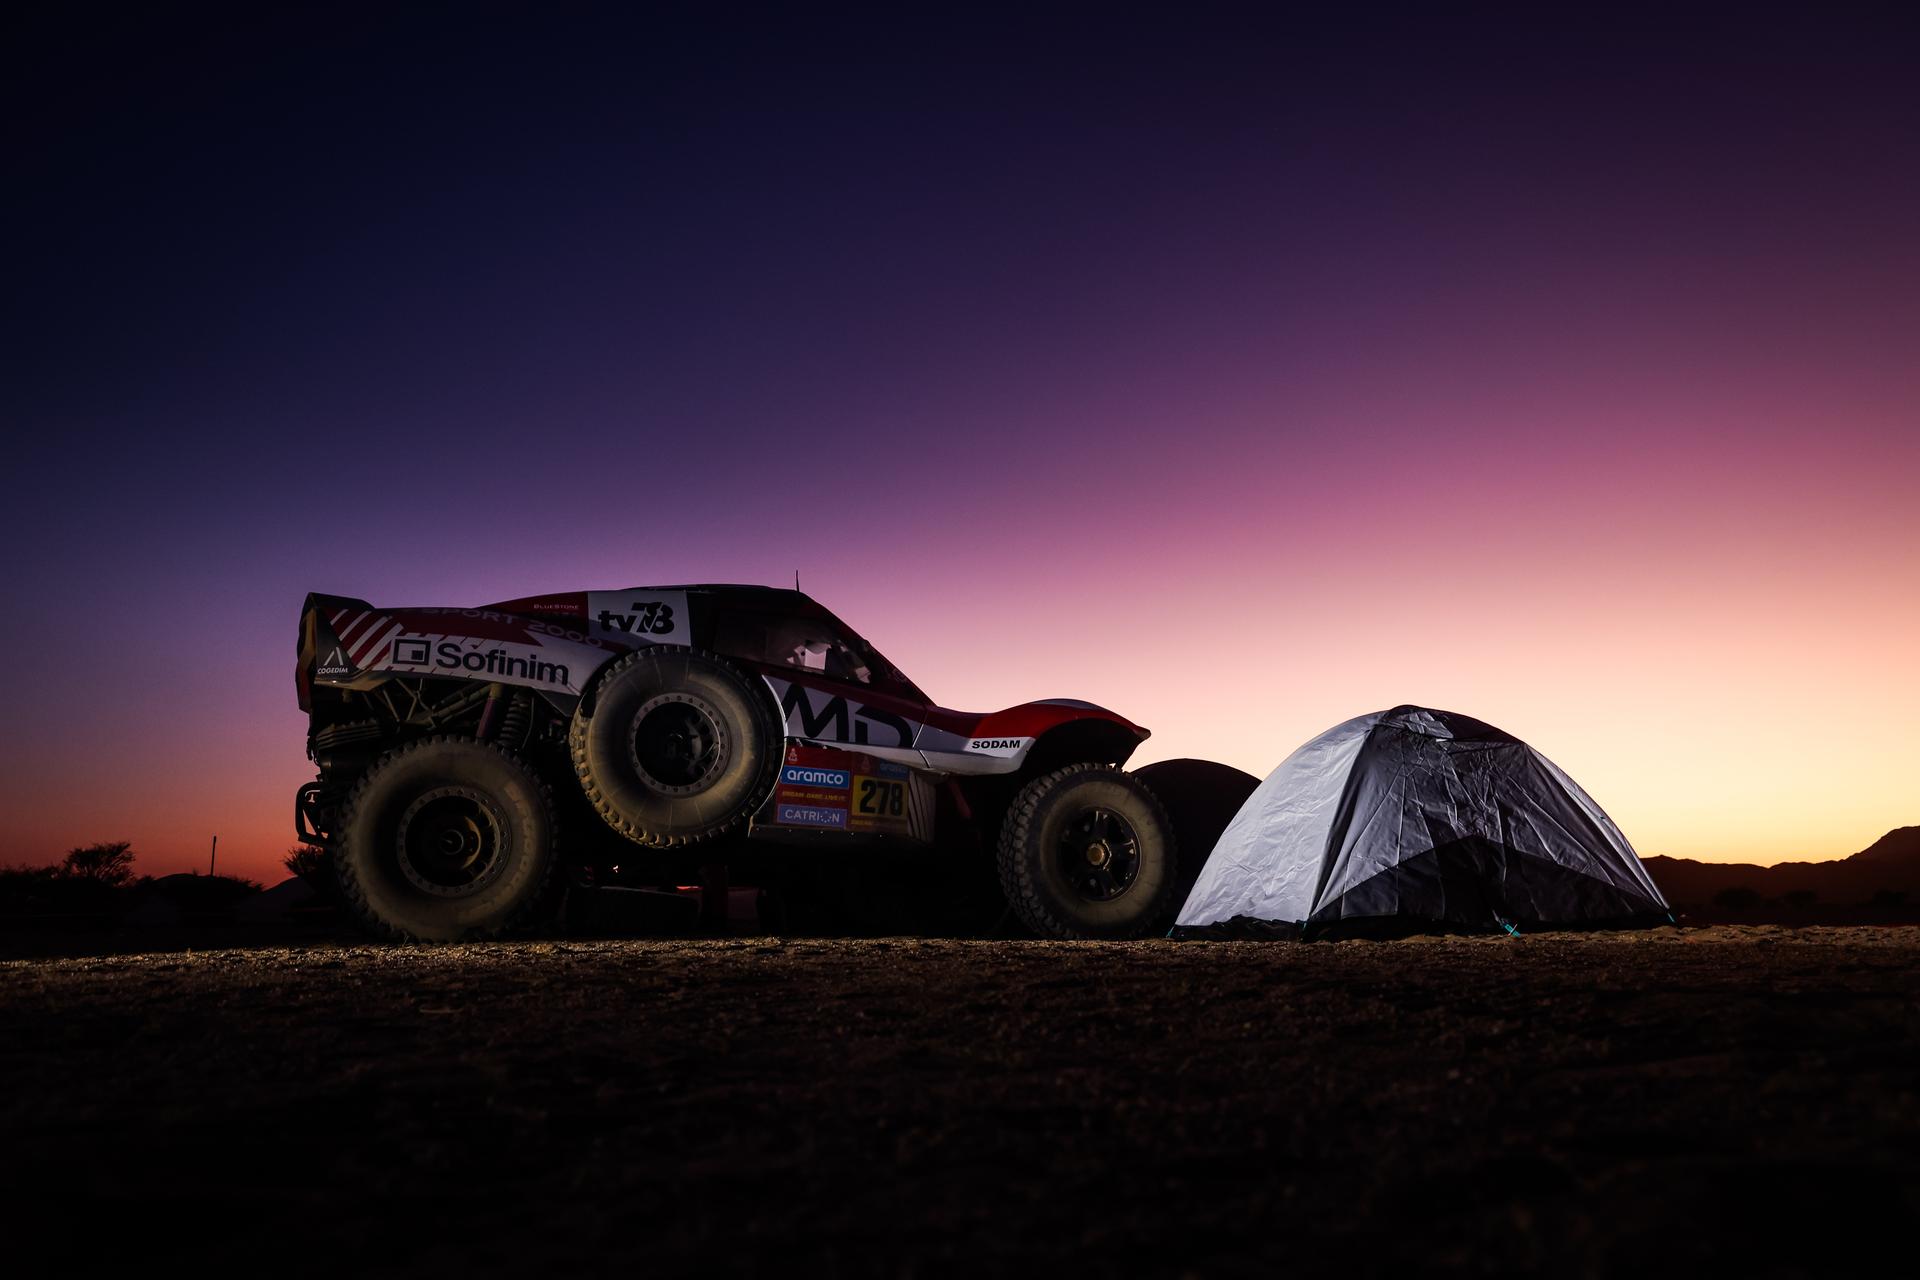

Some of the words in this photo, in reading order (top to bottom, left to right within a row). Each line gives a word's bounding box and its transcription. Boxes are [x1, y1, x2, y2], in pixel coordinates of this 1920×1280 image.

[421, 608, 519, 625] SPORT
[527, 619, 603, 647] 2000
[436, 643, 569, 685] Sofinim
[971, 740, 1021, 749] SODAM
[786, 770, 844, 785] aramco
[860, 780, 903, 816] 278
